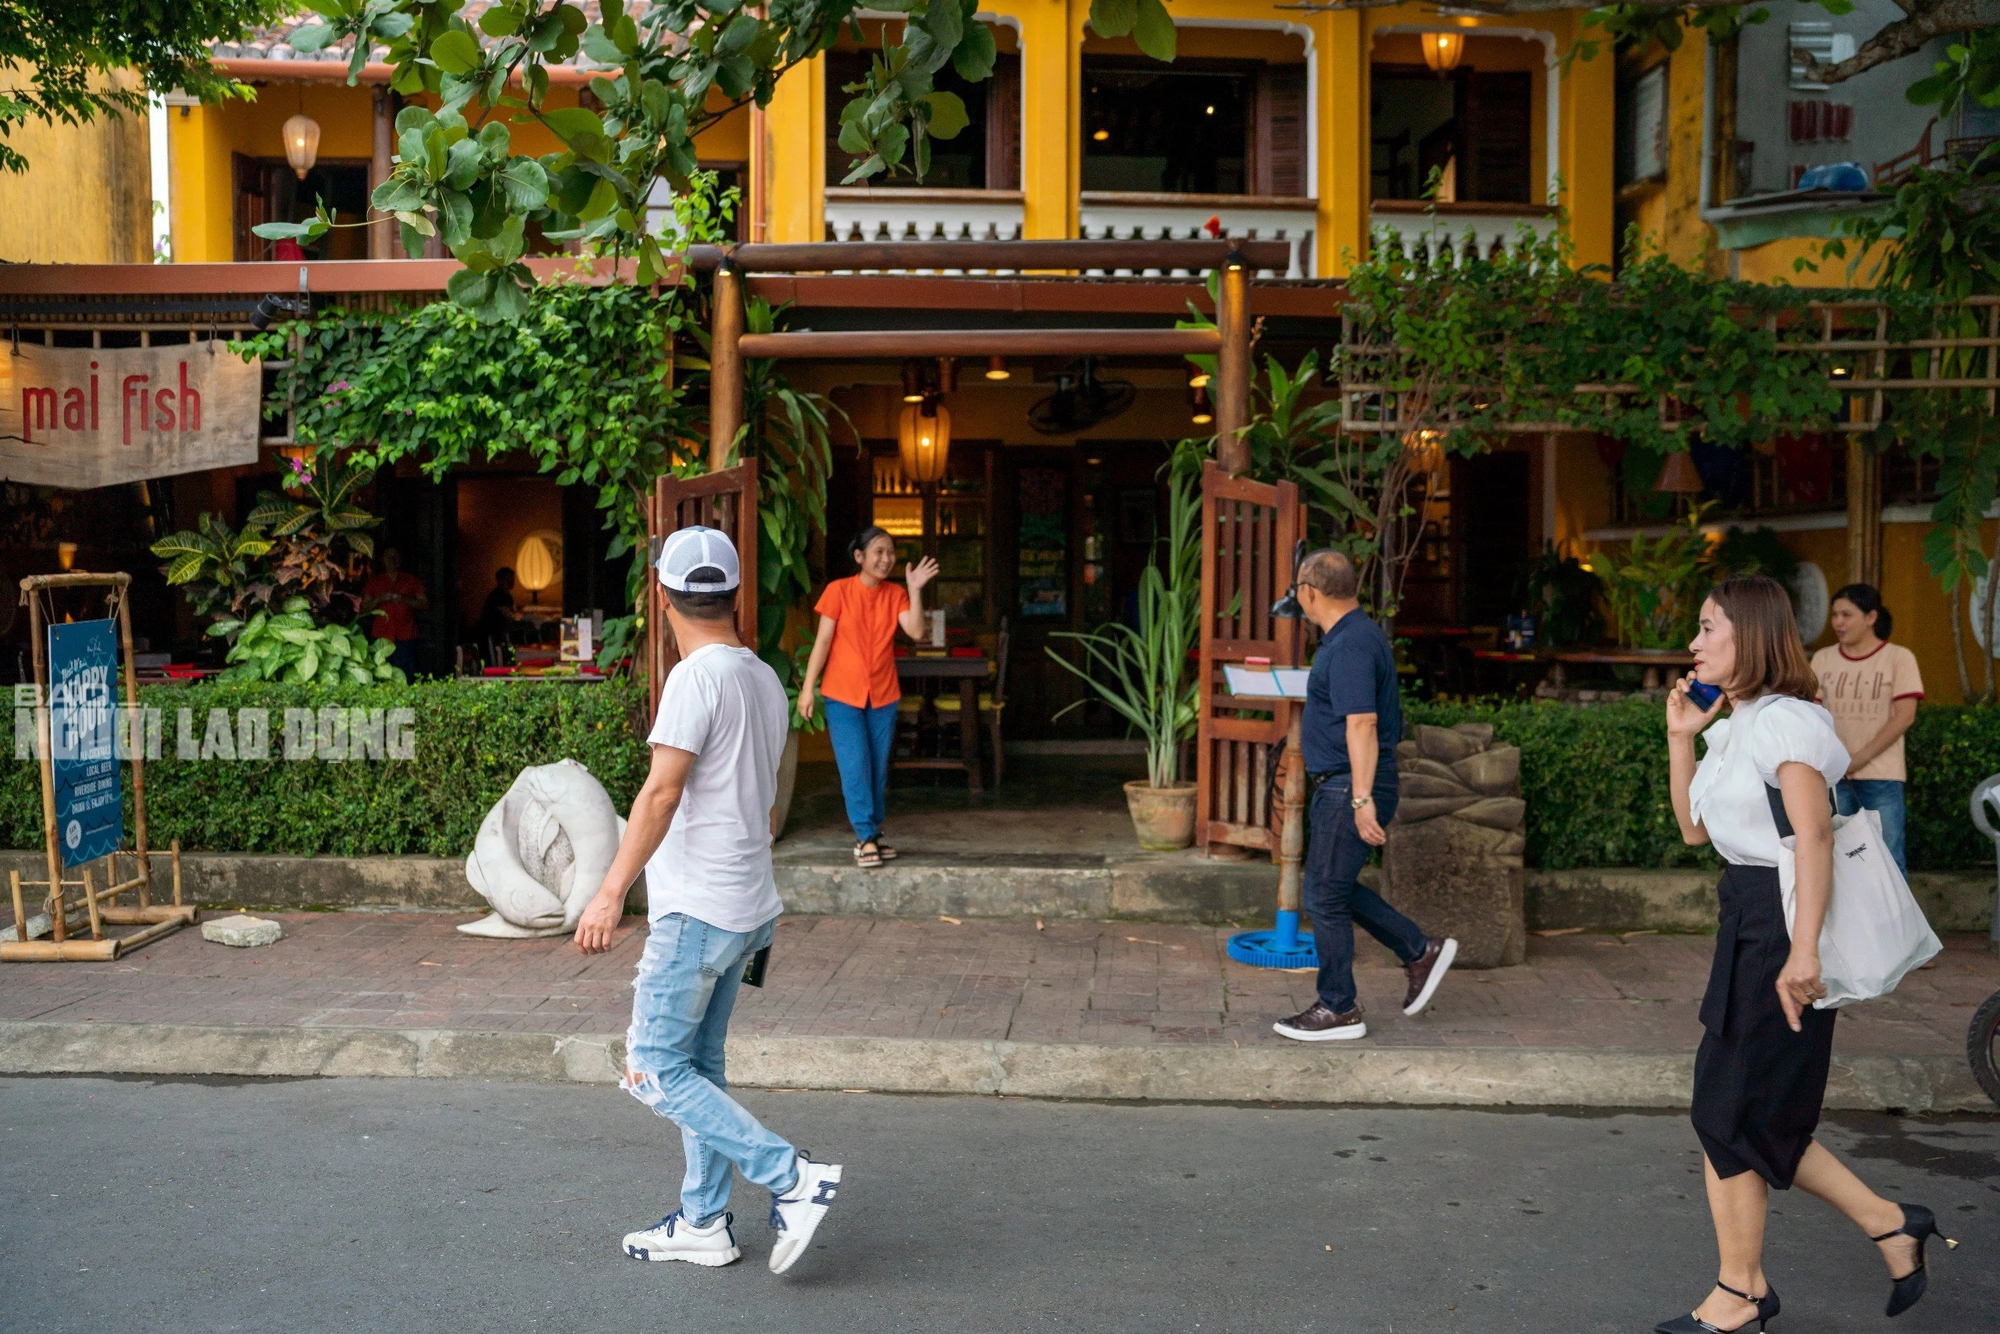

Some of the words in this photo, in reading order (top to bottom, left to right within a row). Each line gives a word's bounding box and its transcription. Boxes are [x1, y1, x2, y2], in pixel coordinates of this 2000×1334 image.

[23, 361, 98, 443] mai
[123, 361, 200, 445] fish
[63, 666, 108, 720] HAPPY
[68, 695, 106, 752] HOUR
[86, 764, 100, 777] LOCAL
[101, 761, 112, 773] BEER
